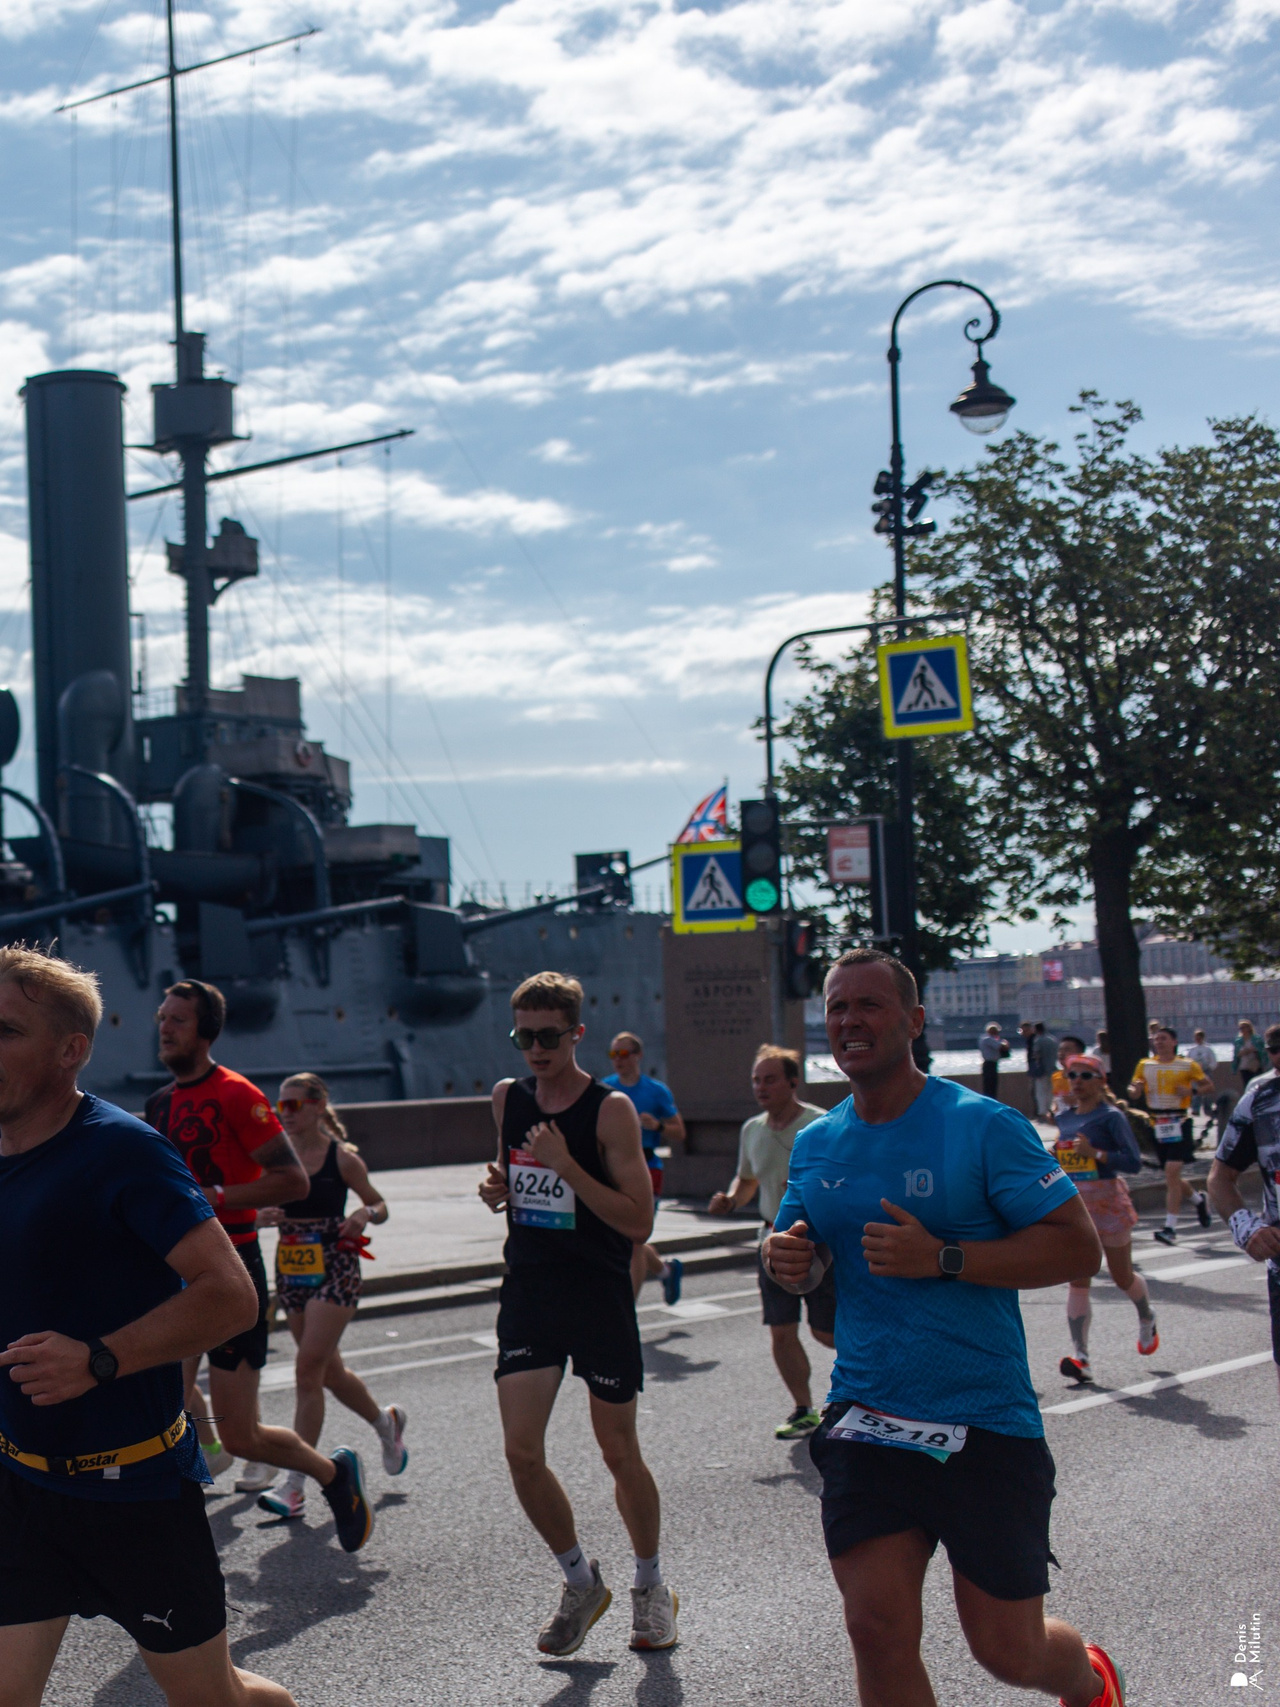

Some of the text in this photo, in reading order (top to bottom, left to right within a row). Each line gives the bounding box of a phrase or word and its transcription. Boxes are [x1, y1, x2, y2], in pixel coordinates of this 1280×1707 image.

[515, 1172, 564, 1198] 6246
[903, 1168, 934, 1198] 10
[840, 1429, 857, 1439] E
[859, 1414, 949, 1447] 5918
